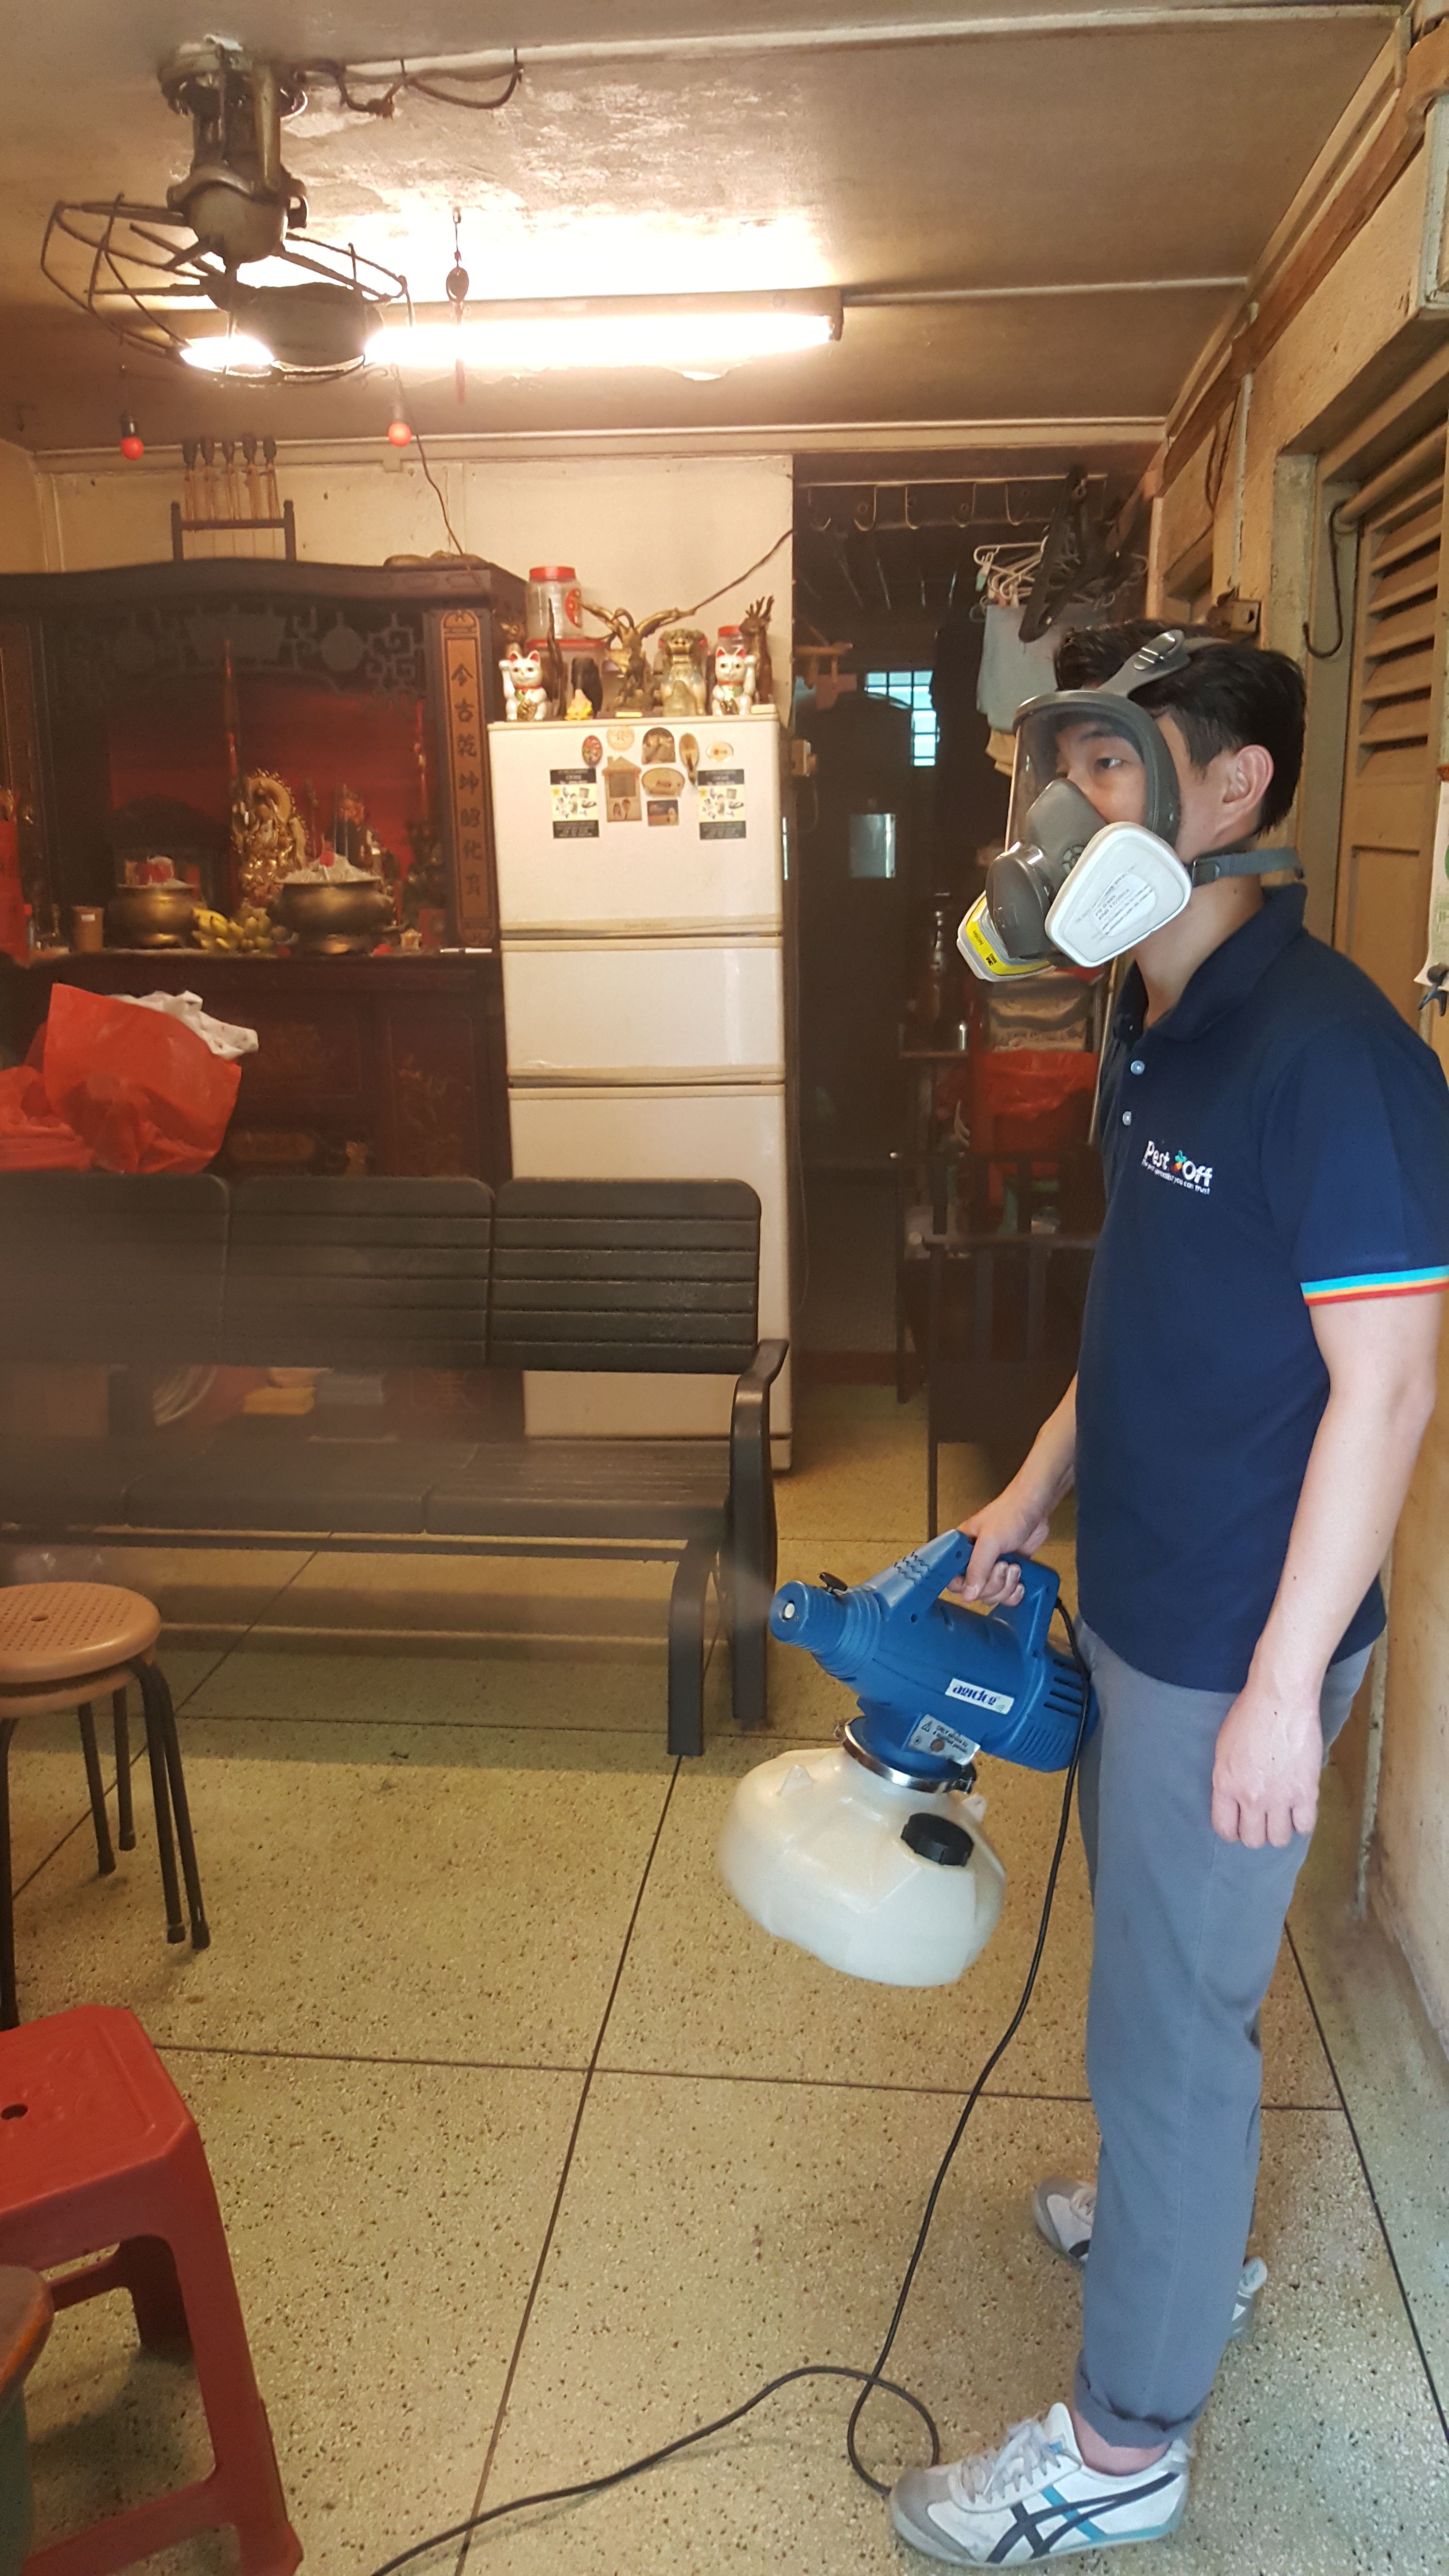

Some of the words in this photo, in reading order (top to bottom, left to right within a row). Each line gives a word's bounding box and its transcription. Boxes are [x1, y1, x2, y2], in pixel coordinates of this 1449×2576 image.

[1143, 1141, 1170, 1170] Pest
[1182, 1160, 1213, 1187] Off
[1173, 1177, 1183, 1185] you
[1183, 1181, 1194, 1190] can
[1194, 1185, 1210, 1195] trust
